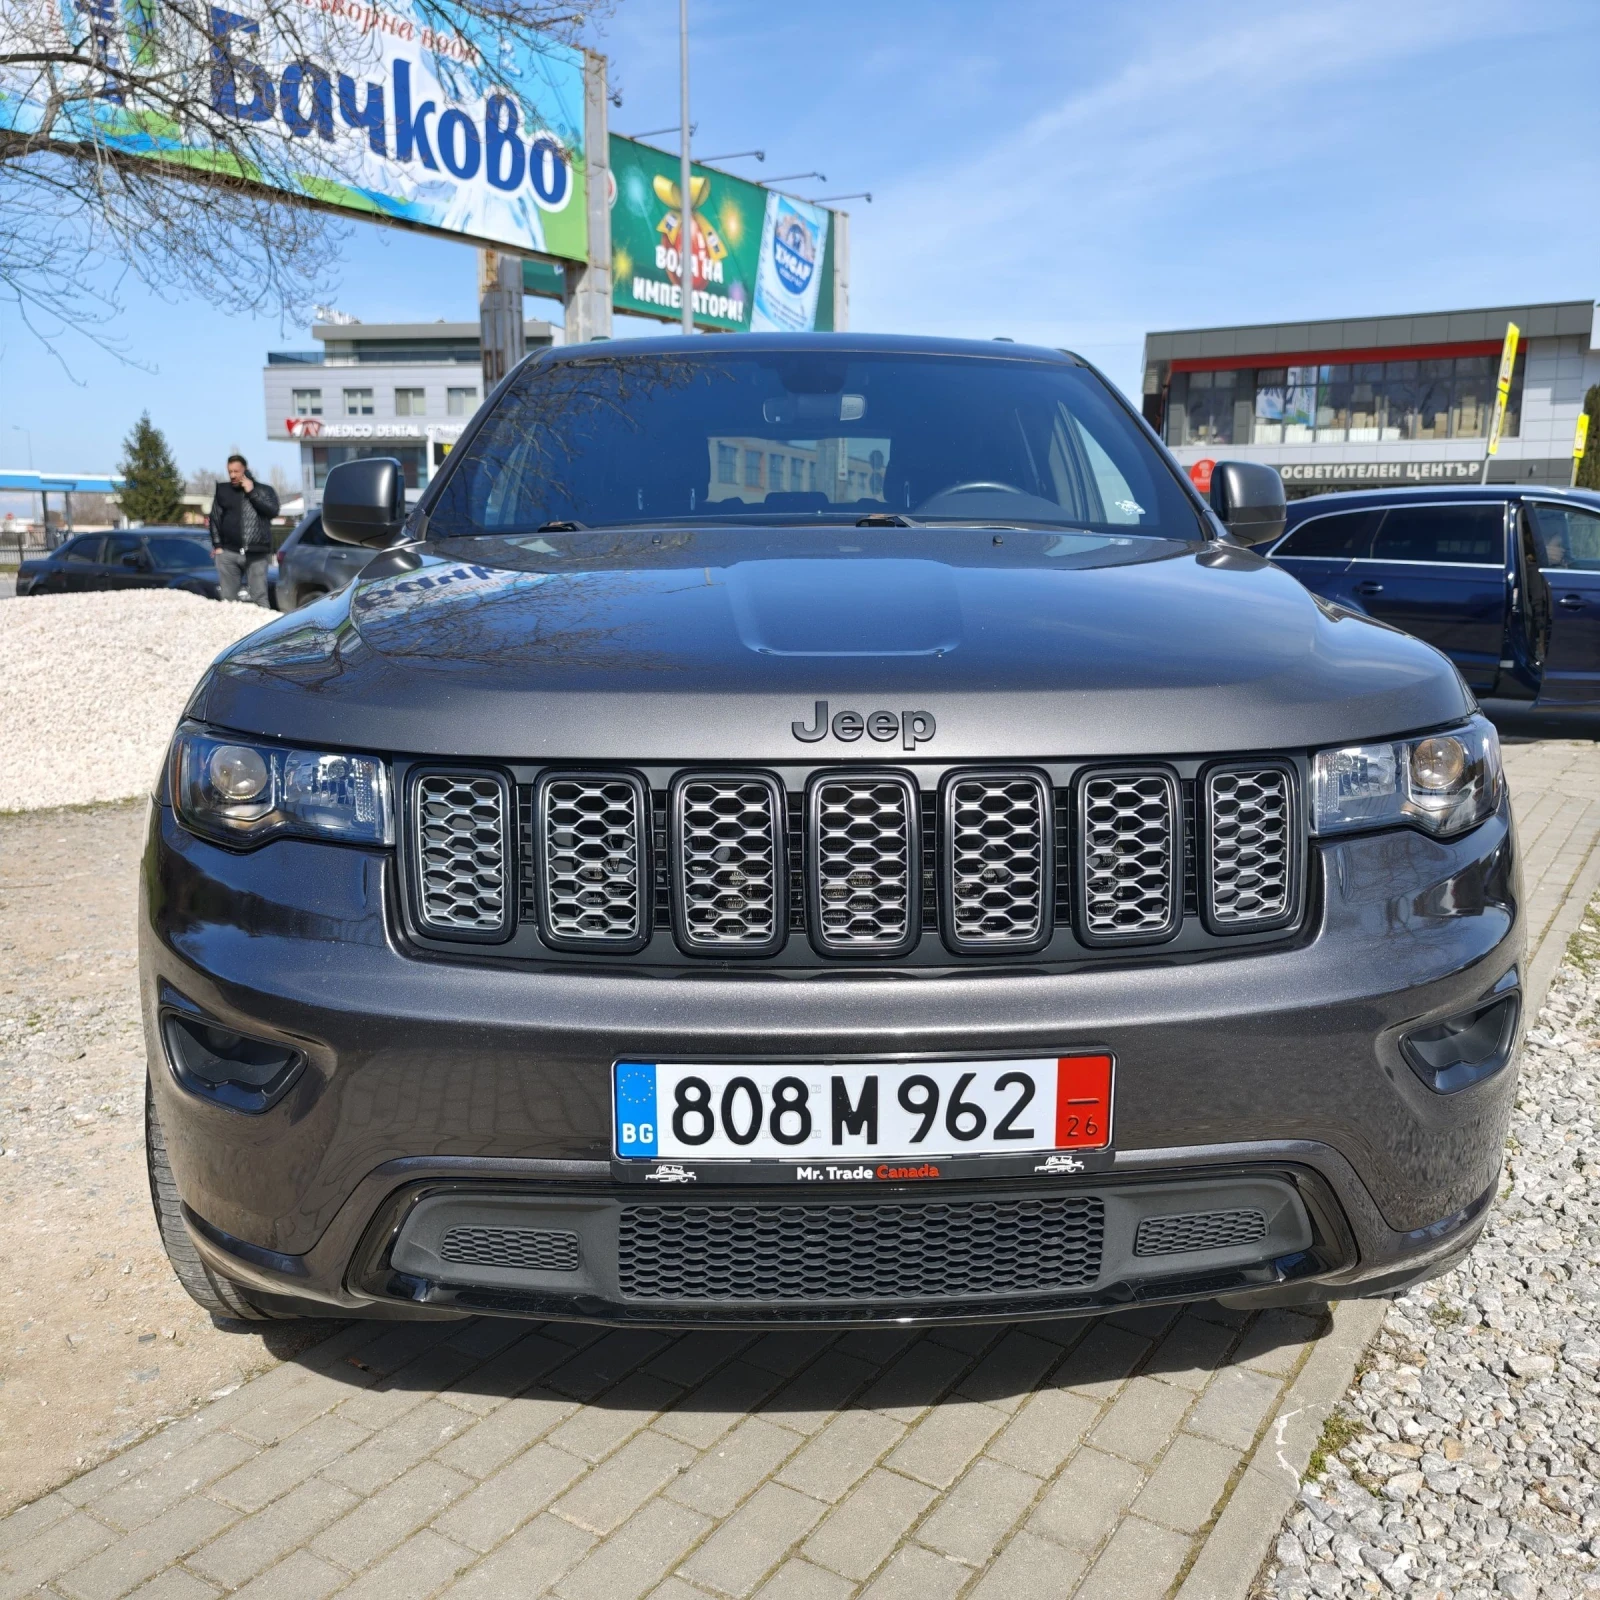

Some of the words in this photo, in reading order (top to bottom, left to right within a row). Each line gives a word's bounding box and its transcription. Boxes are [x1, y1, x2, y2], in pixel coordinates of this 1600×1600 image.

[210, 6, 567, 205] Бачково
[702, 257, 724, 284] НА
[633, 276, 744, 322] ИМПЕАТОРИ!
[324, 423, 371, 437] MEDICO
[377, 423, 420, 437] DENTAL
[1280, 463, 1401, 479] ОСВЕТИТЕЛЕН
[1406, 463, 1480, 481] ЦЕНТЪР
[792, 700, 937, 751] Jeep
[672, 1076, 812, 1146] 808
[831, 1075, 878, 1146] M
[897, 1071, 1036, 1143] 962
[622, 1123, 654, 1144] BG
[1067, 1114, 1099, 1137] 26
[797, 1166, 823, 1180] Mr.
[826, 1165, 873, 1180] Trade
[877, 1164, 940, 1180] Canada
